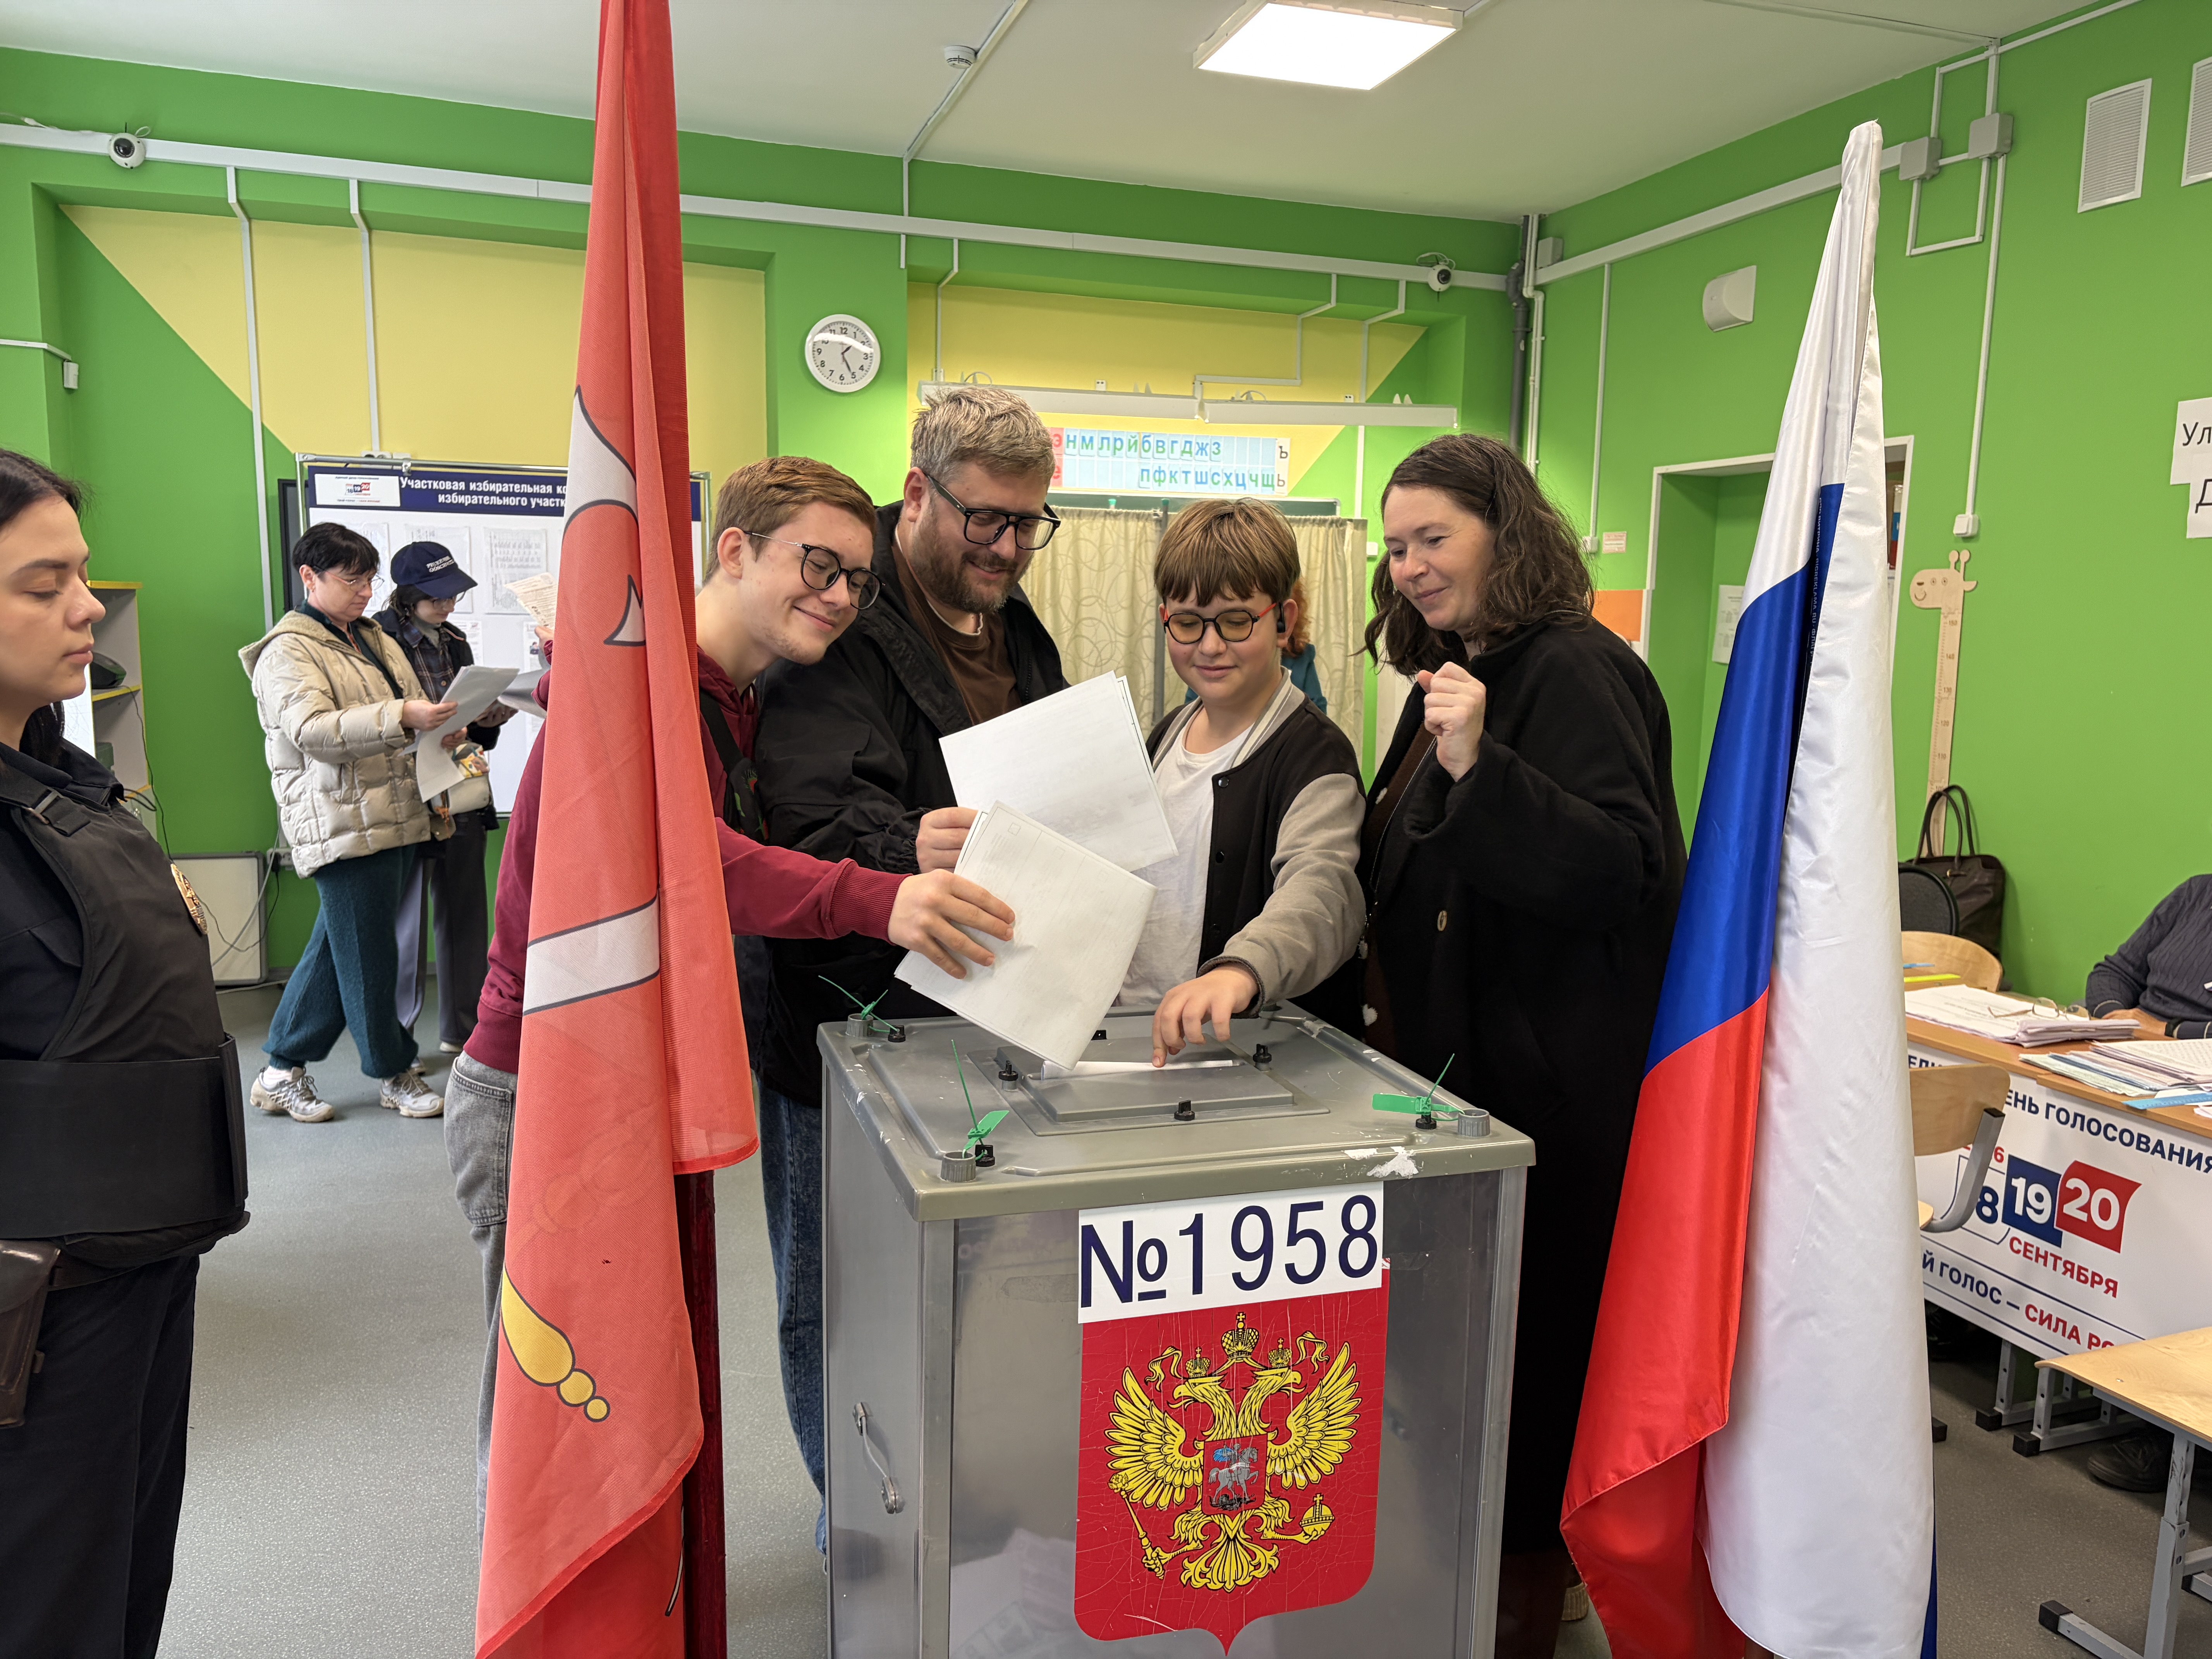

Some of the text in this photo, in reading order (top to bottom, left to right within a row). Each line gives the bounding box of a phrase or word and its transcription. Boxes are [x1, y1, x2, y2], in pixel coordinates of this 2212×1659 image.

[400, 476, 465, 491] Участковая
[469, 480, 552, 495] избирательная
[438, 492, 527, 506] избирательного
[2005, 1089, 2212, 1174] ЕНЬ ГОЛОСОВАНИЯ
[1975, 1176, 2120, 1231] 8 19 20
[1080, 1194, 1379, 1309] №1958
[2009, 1236, 2118, 1299] СЕНТЯБРЯ
[1922, 1249, 1935, 1273] Й
[1939, 1261, 2002, 1305] ГОЛОС
[2025, 1304, 2081, 1345] СИЛА
